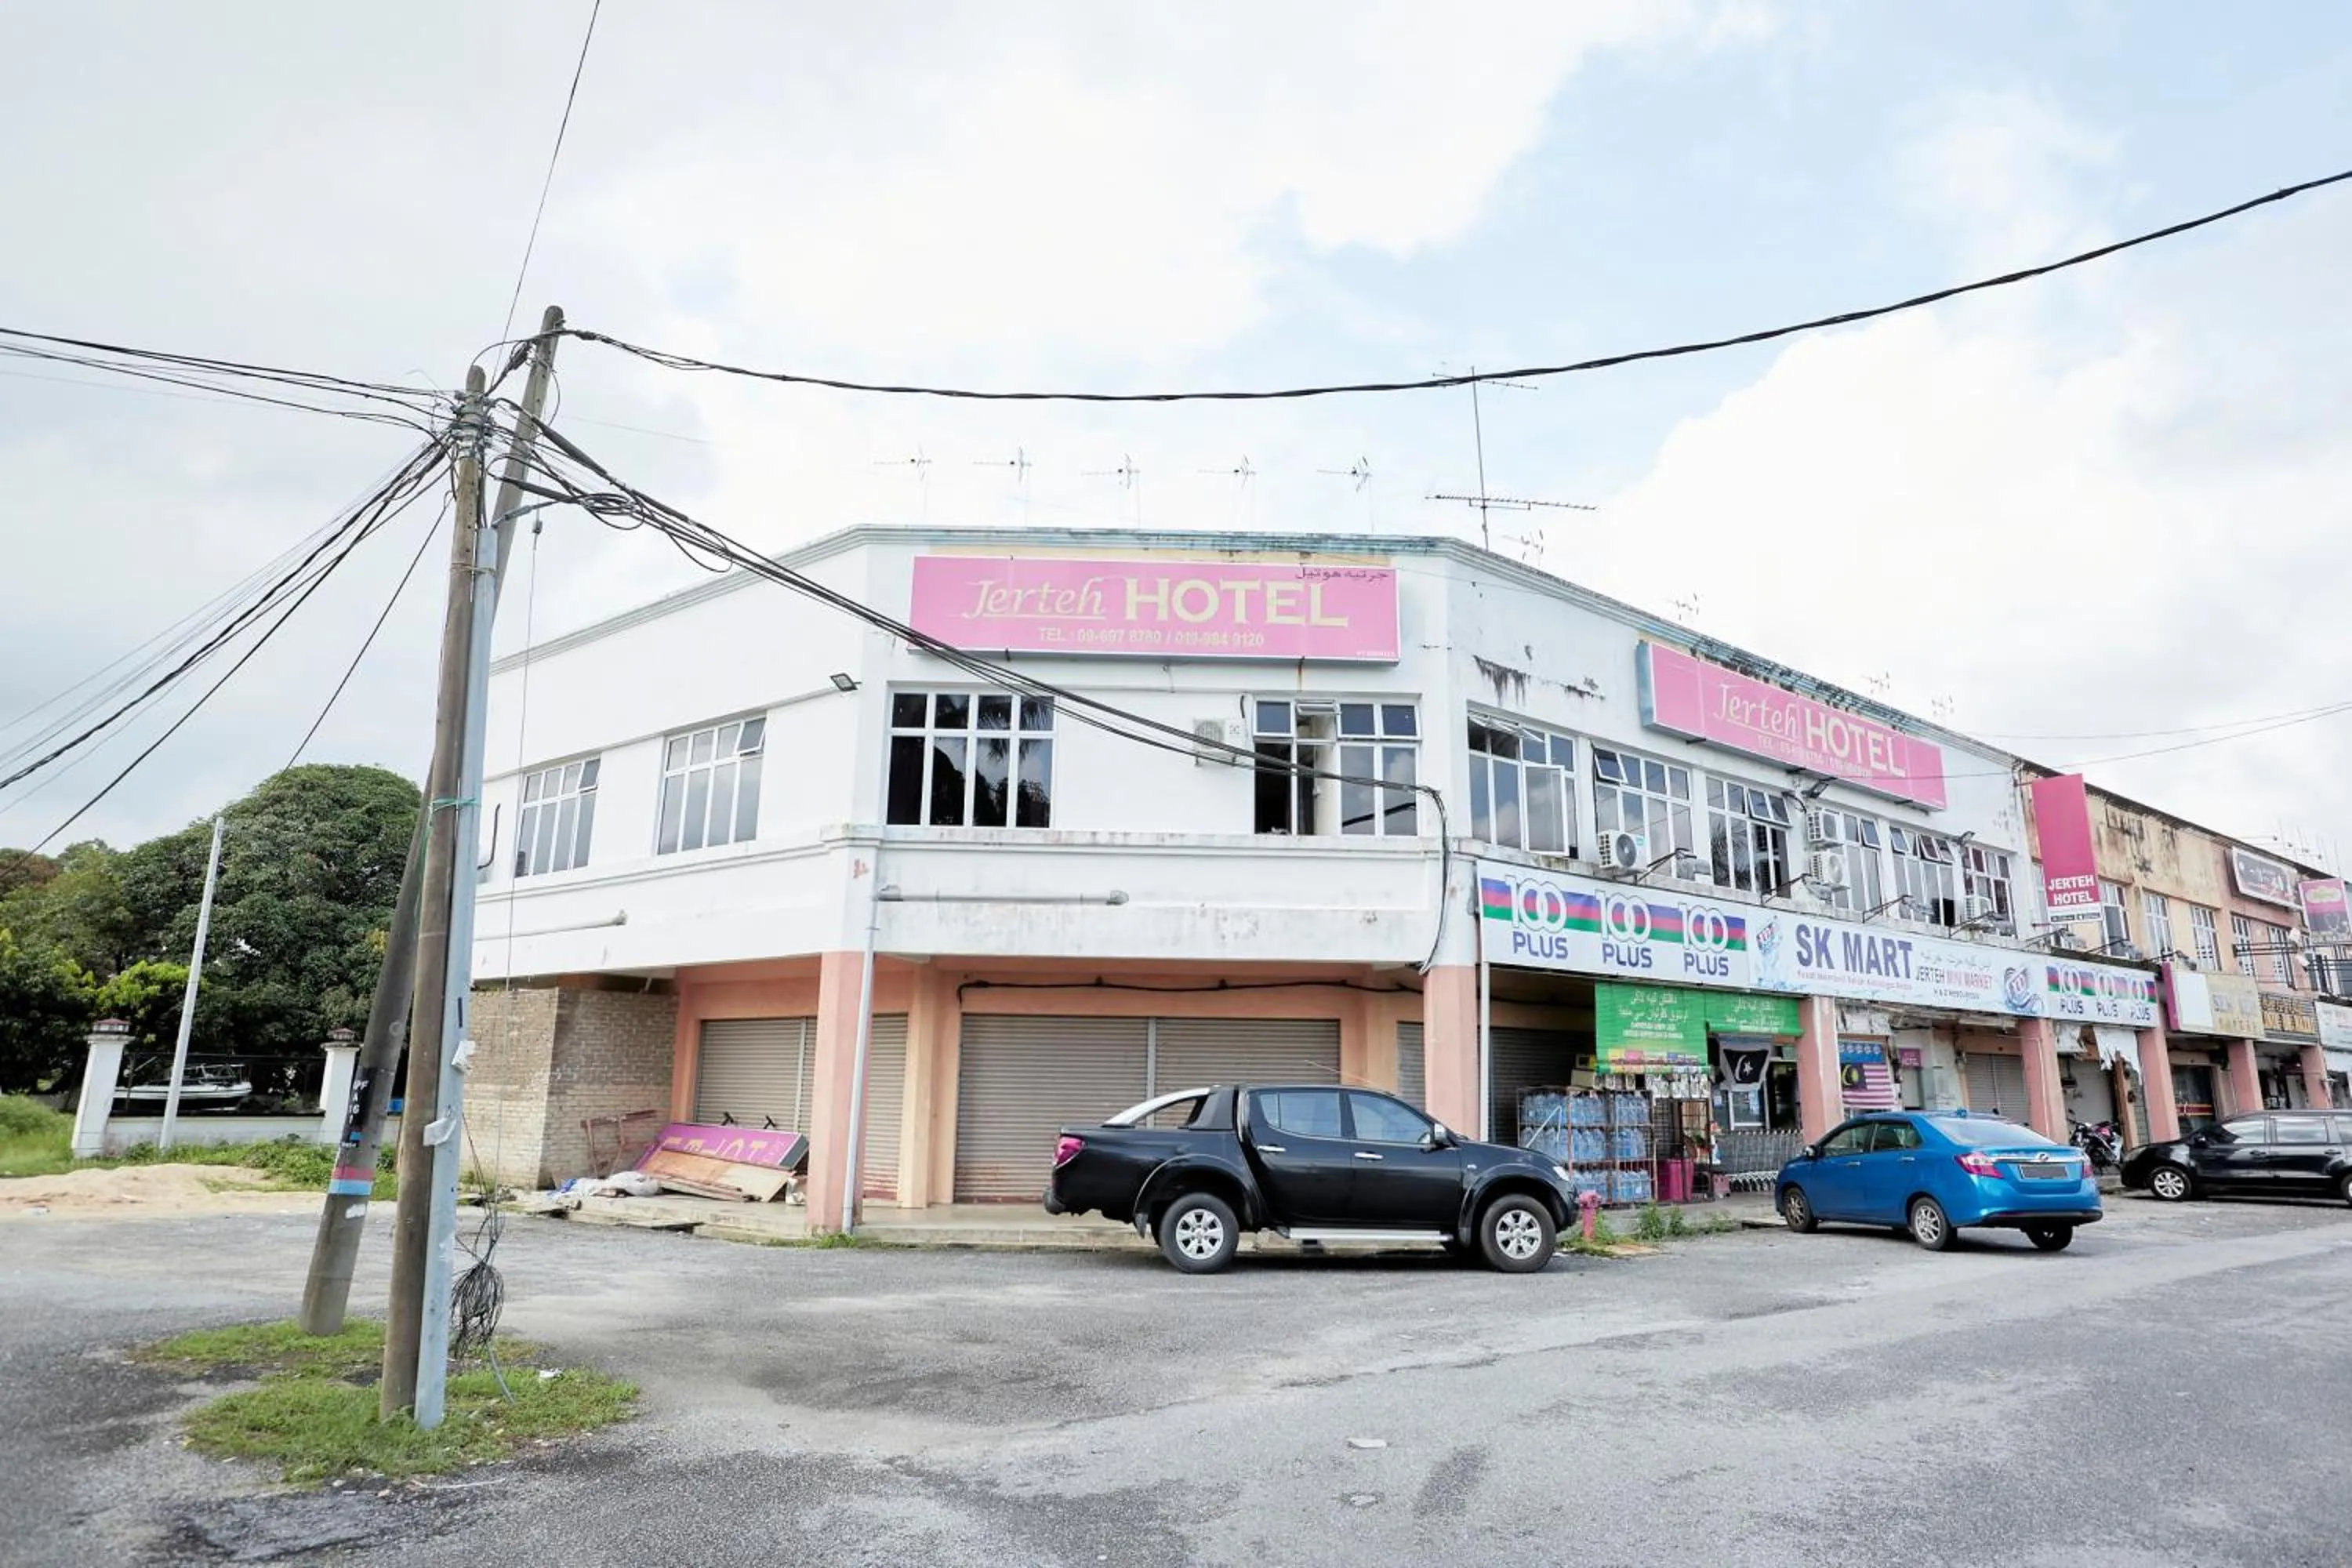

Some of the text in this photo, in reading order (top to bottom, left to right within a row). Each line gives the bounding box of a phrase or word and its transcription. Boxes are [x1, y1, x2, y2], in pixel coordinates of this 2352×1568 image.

[963, 576, 1349, 628] Jerteh HOTEL
[1713, 683, 1799, 739] Jerteh
[1805, 707, 1906, 778] HOTEL
[2048, 874, 2095, 891] JERTEH
[1504, 875, 1567, 933] 100
[2053, 891, 2094, 905] HOTEL
[1595, 888, 1652, 944] 100
[1678, 902, 1729, 953] 100
[1512, 931, 1568, 960] PLUS
[1602, 943, 1653, 969] PLUS
[1796, 924, 1835, 970] SK
[1842, 931, 1914, 980] MART
[1684, 952, 1730, 977] PLUS
[1915, 965, 1944, 983] JERTEH
[2060, 998, 2084, 1014] PLUS
